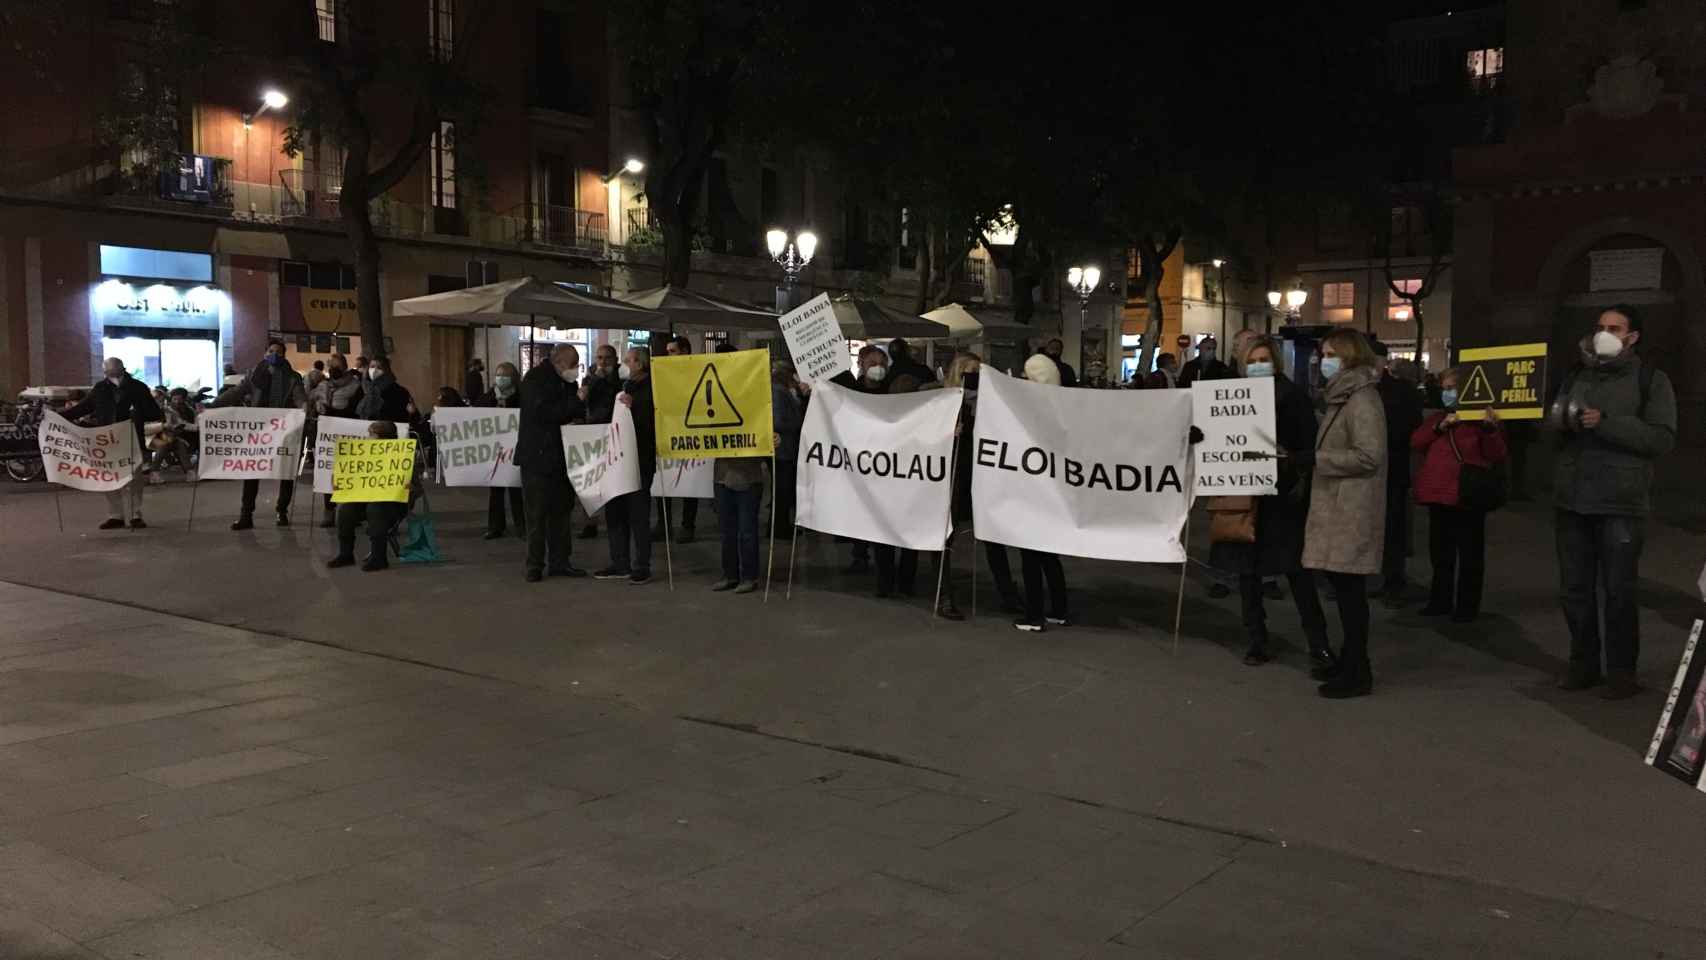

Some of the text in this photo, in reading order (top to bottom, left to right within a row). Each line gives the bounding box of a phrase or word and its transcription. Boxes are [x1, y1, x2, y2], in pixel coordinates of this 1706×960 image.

[782, 314, 804, 331] ELOI
[803, 300, 831, 319] BADIA
[795, 335, 842, 365] DESTRUINT
[808, 350, 836, 369] ESPAIS
[1505, 360, 1536, 375] PARC
[1215, 388, 1250, 401] ELOI
[1502, 388, 1537, 403] PERILL
[1211, 404, 1257, 417] BADIA
[205, 420, 266, 431] INSTITUT
[437, 414, 518, 443] RAMBLA
[247, 433, 273, 445] NO
[671, 433, 757, 450] PARC EN PERILL
[1226, 434, 1247, 446] NO
[205, 446, 294, 456] DESTRUINT EL
[338, 441, 414, 456] ELS ESPAIS
[339, 460, 383, 474] VERDS
[390, 458, 412, 471] NO
[806, 441, 946, 482] ADA COLAU
[977, 438, 1182, 493] ELOI BADIA
[336, 477, 354, 490] ES
[1199, 475, 1225, 487] ALS
